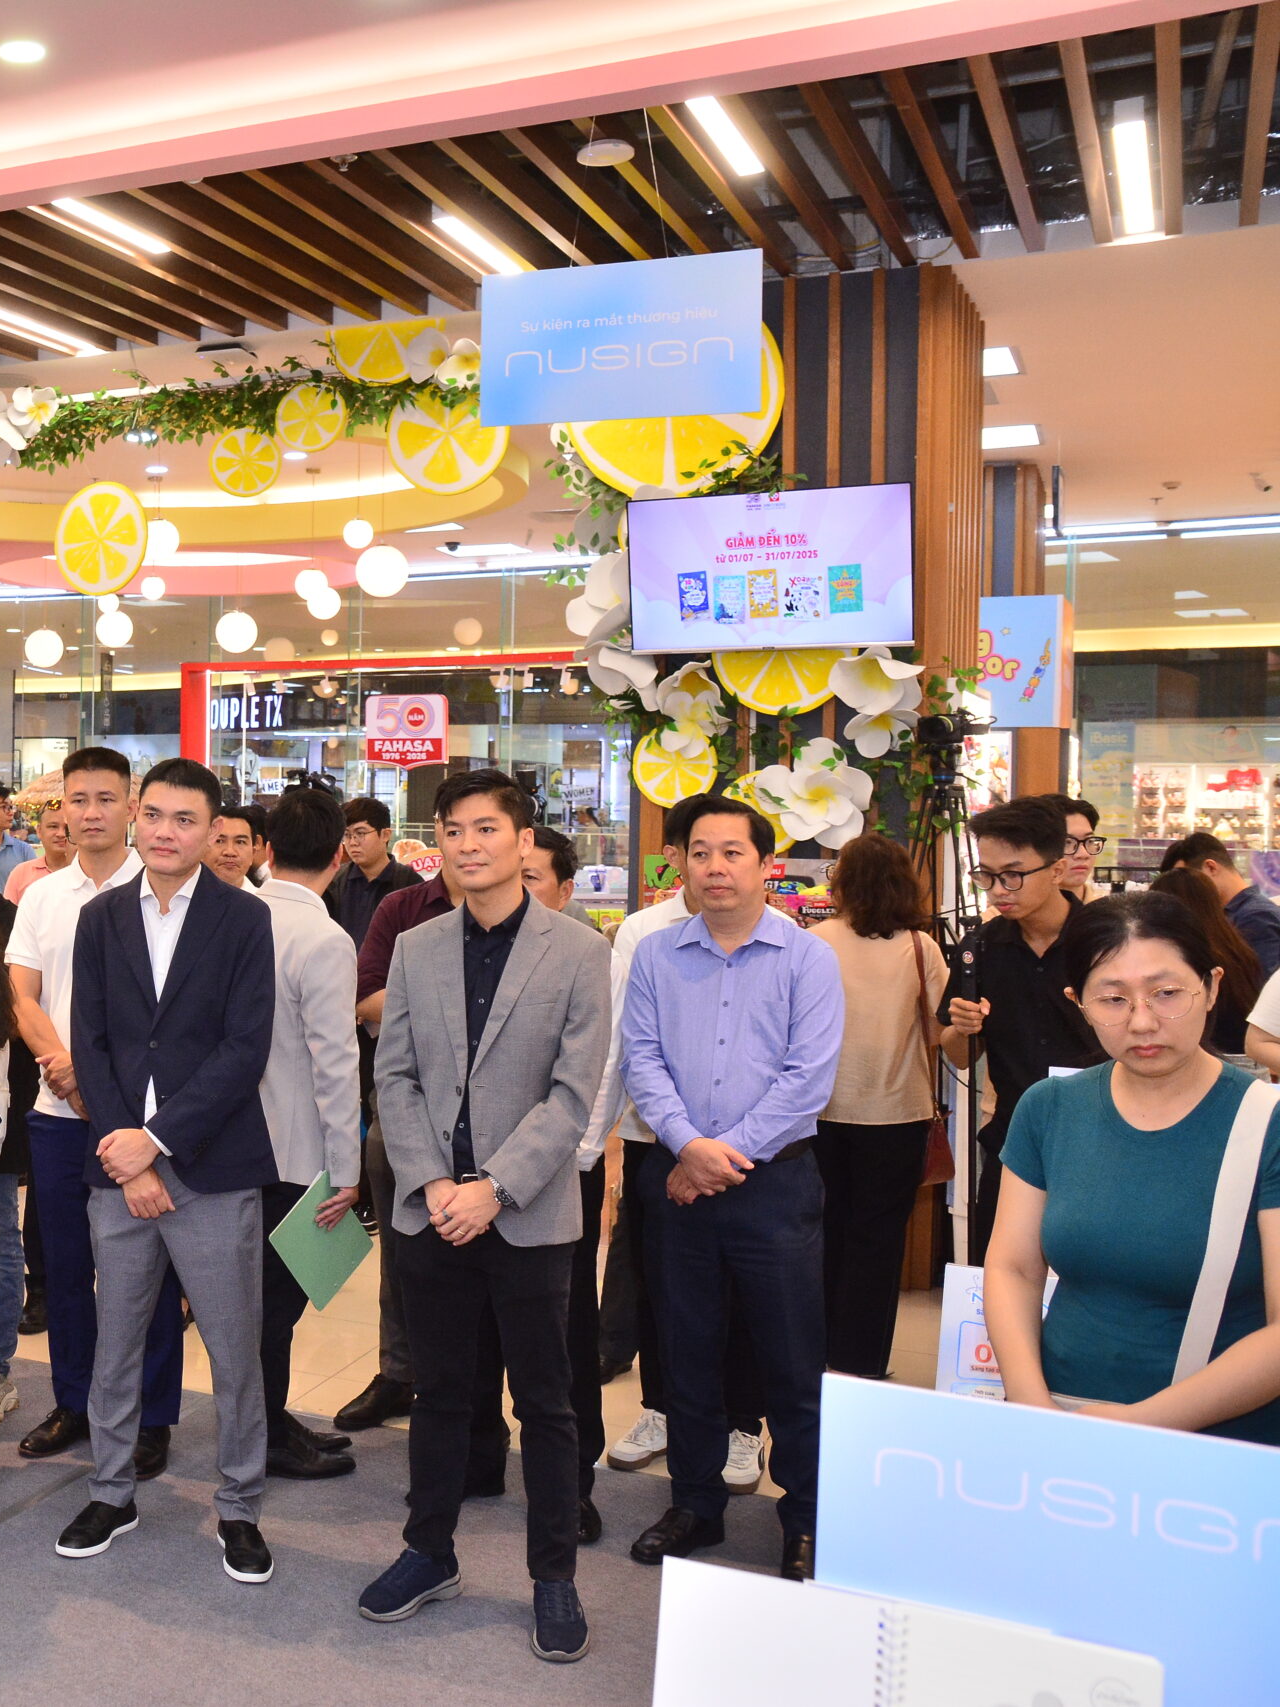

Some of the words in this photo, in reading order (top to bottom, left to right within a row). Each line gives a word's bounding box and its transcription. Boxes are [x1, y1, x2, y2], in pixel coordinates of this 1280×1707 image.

[577, 319, 590, 328] ra
[726, 532, 754, 548] GIẢM
[759, 529, 780, 547] ĐẾN
[785, 534, 808, 546] 10%
[728, 553, 753, 563] 01/07
[765, 550, 818, 561] 31/07/2025
[210, 697, 259, 730] OUPLE
[264, 695, 283, 727] TX
[377, 697, 435, 737] 50
[374, 740, 434, 752] FAHASA
[382, 752, 400, 760] 1976
[406, 752, 427, 760] 2026
[410, 855, 443, 872] UẠT
